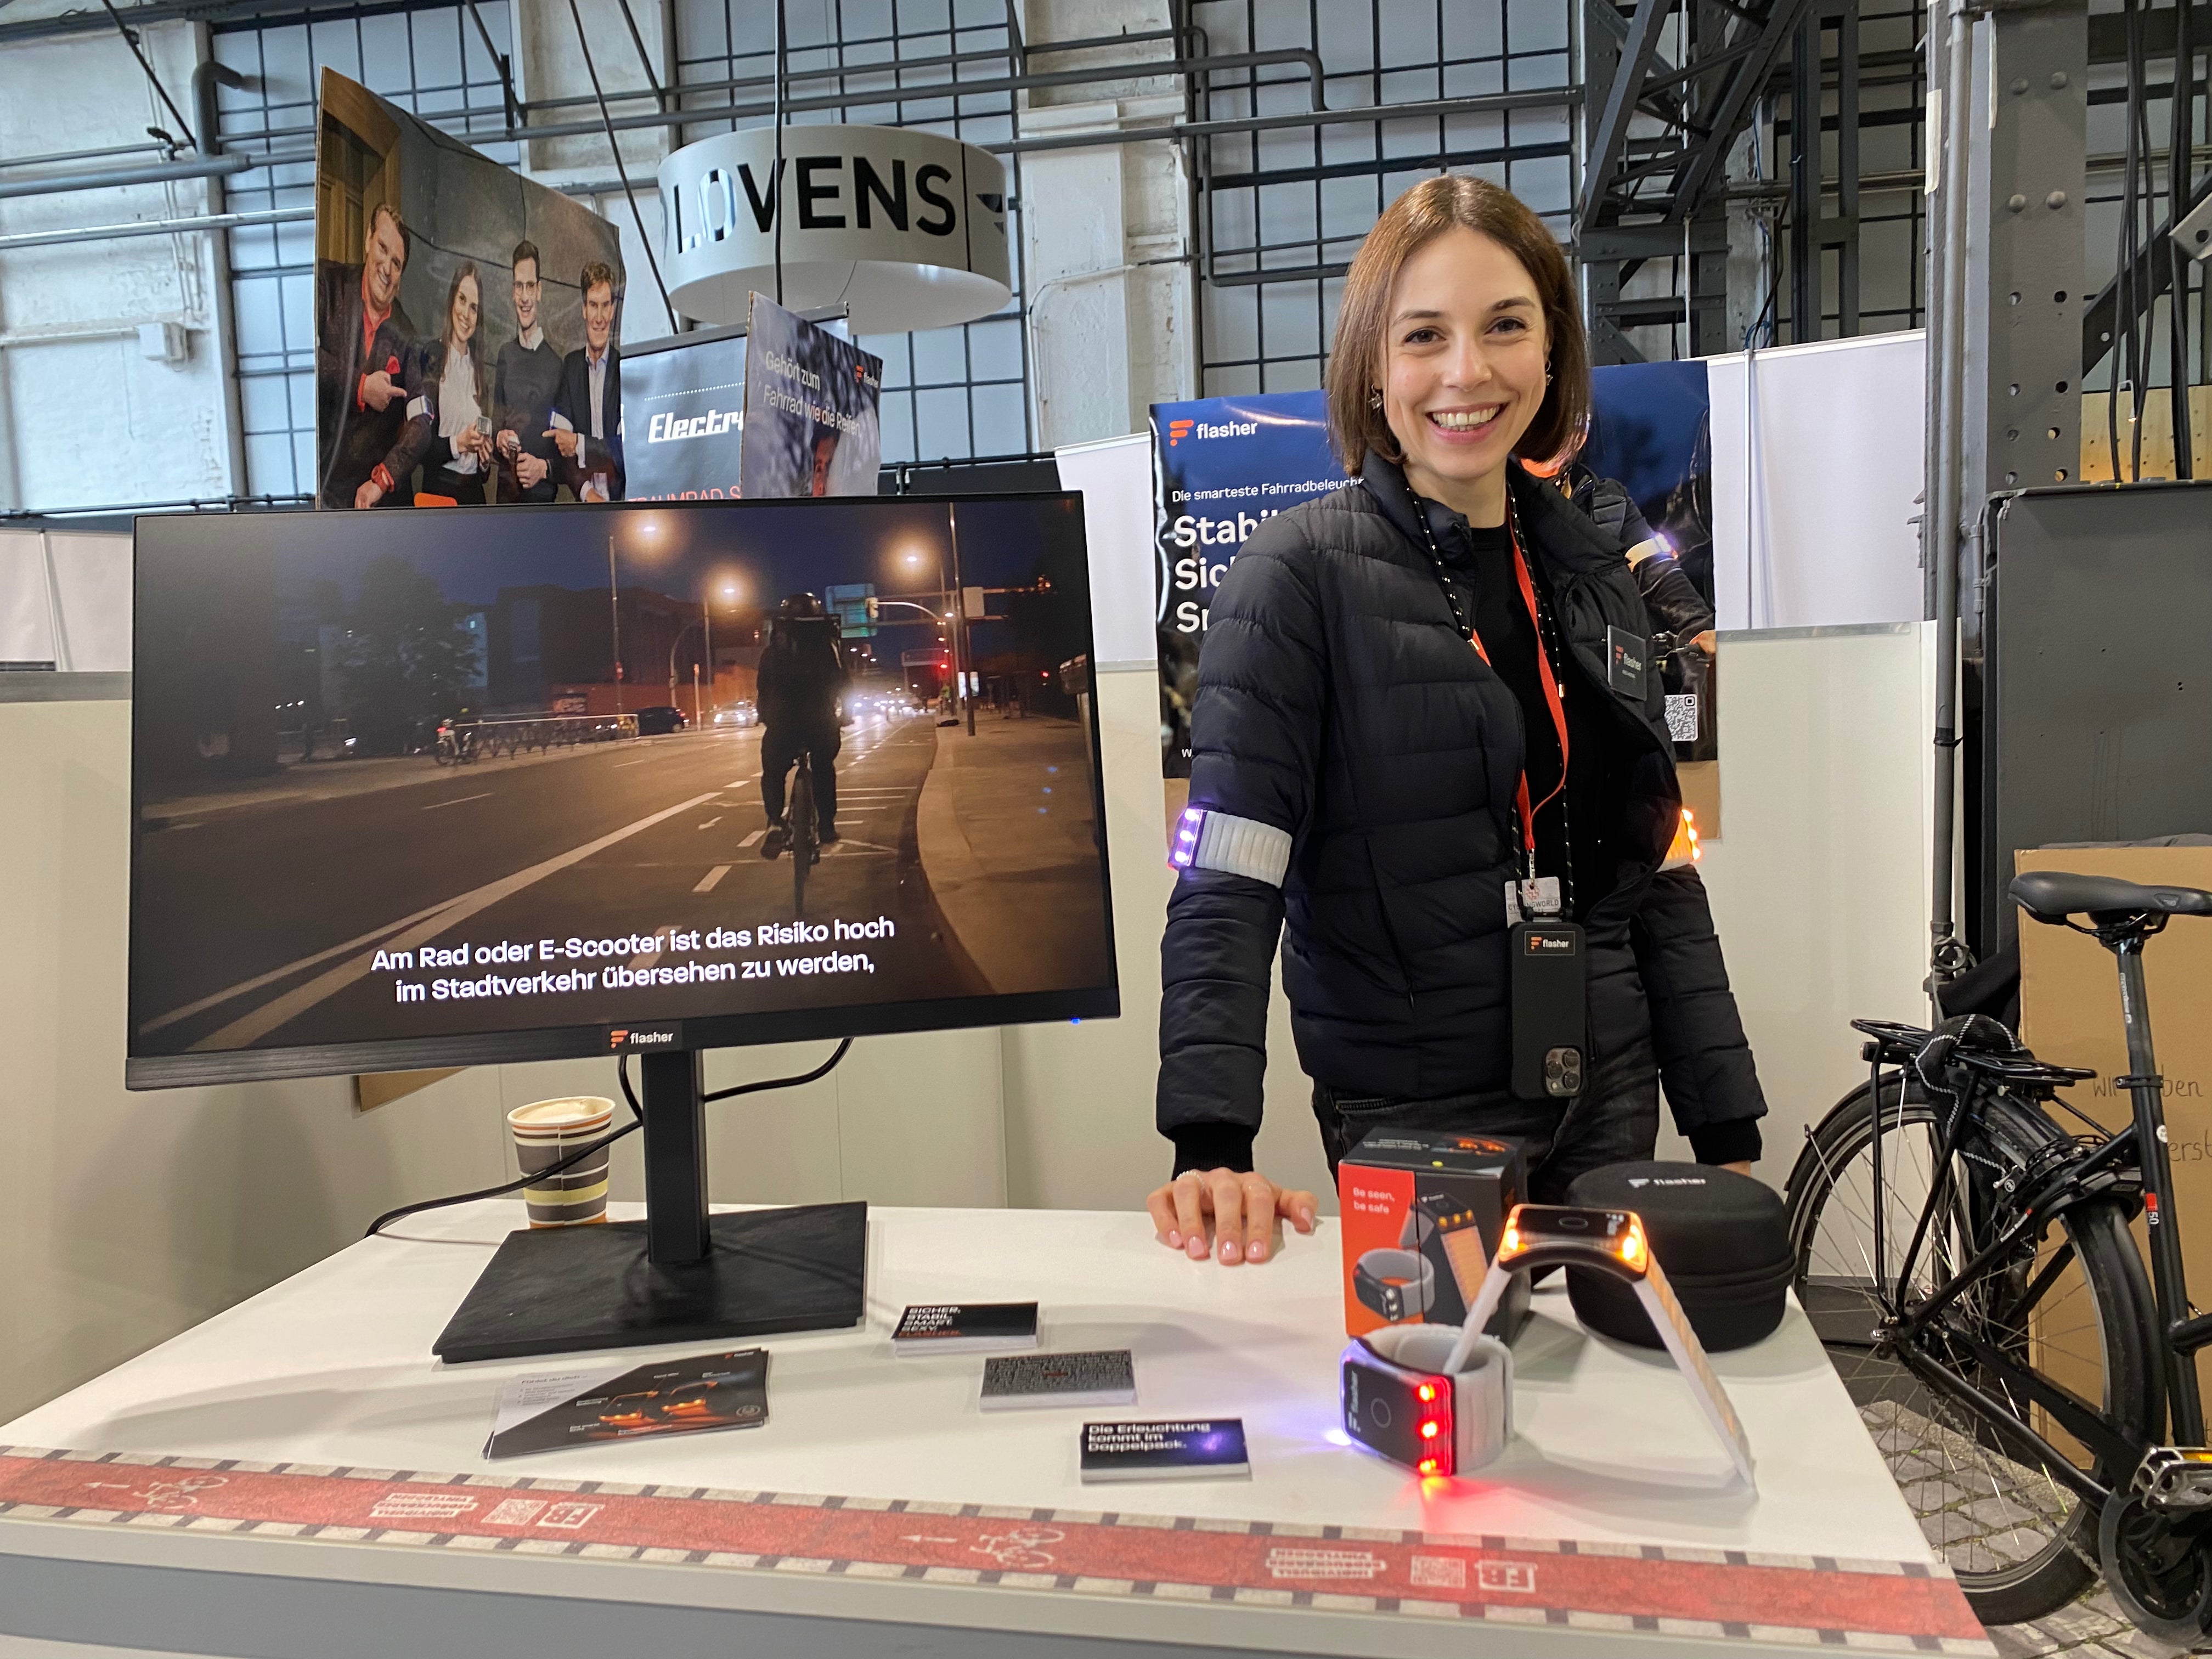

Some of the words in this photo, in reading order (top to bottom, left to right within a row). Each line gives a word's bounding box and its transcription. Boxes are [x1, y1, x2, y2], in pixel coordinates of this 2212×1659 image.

[675, 155, 956, 255] LOVENS
[766, 351, 800, 382] Gehört
[801, 369, 820, 391] zum
[764, 385, 803, 415] Fahrrad
[804, 400, 820, 422] wie
[822, 405, 836, 427] die
[1197, 421, 1257, 439] flasher
[1172, 490, 1191, 502] Die
[1194, 486, 1259, 500] smarteste
[370, 950, 413, 970] Am
[420, 943, 469, 968] Rad
[475, 941, 533, 964] oder
[539, 934, 665, 960] E-Scooter
[670, 930, 701, 951] ist
[706, 927, 752, 949] das
[758, 921, 828, 945] Risiko
[834, 916, 894, 940] hoch
[1543, 939, 1569, 947] flasher
[396, 980, 425, 1002] im
[432, 968, 597, 1000] Stadtverkehr
[602, 961, 736, 988] übersehen
[741, 959, 771, 979] zu
[776, 951, 874, 974] werden,
[630, 1031, 674, 1044] flasher
[1353, 1187, 1365, 1197] Be
[1368, 1190, 1395, 1202] seen,
[1353, 1200, 1366, 1211] be
[1368, 1204, 1390, 1214] safe
[1089, 1424, 1114, 1434] Die
[1117, 1423, 1211, 1434] Erleuchtung
[1088, 1434, 1142, 1443] kommt
[1144, 1432, 1163, 1442] im
[1088, 1440, 1187, 1452] Doppelpack.
